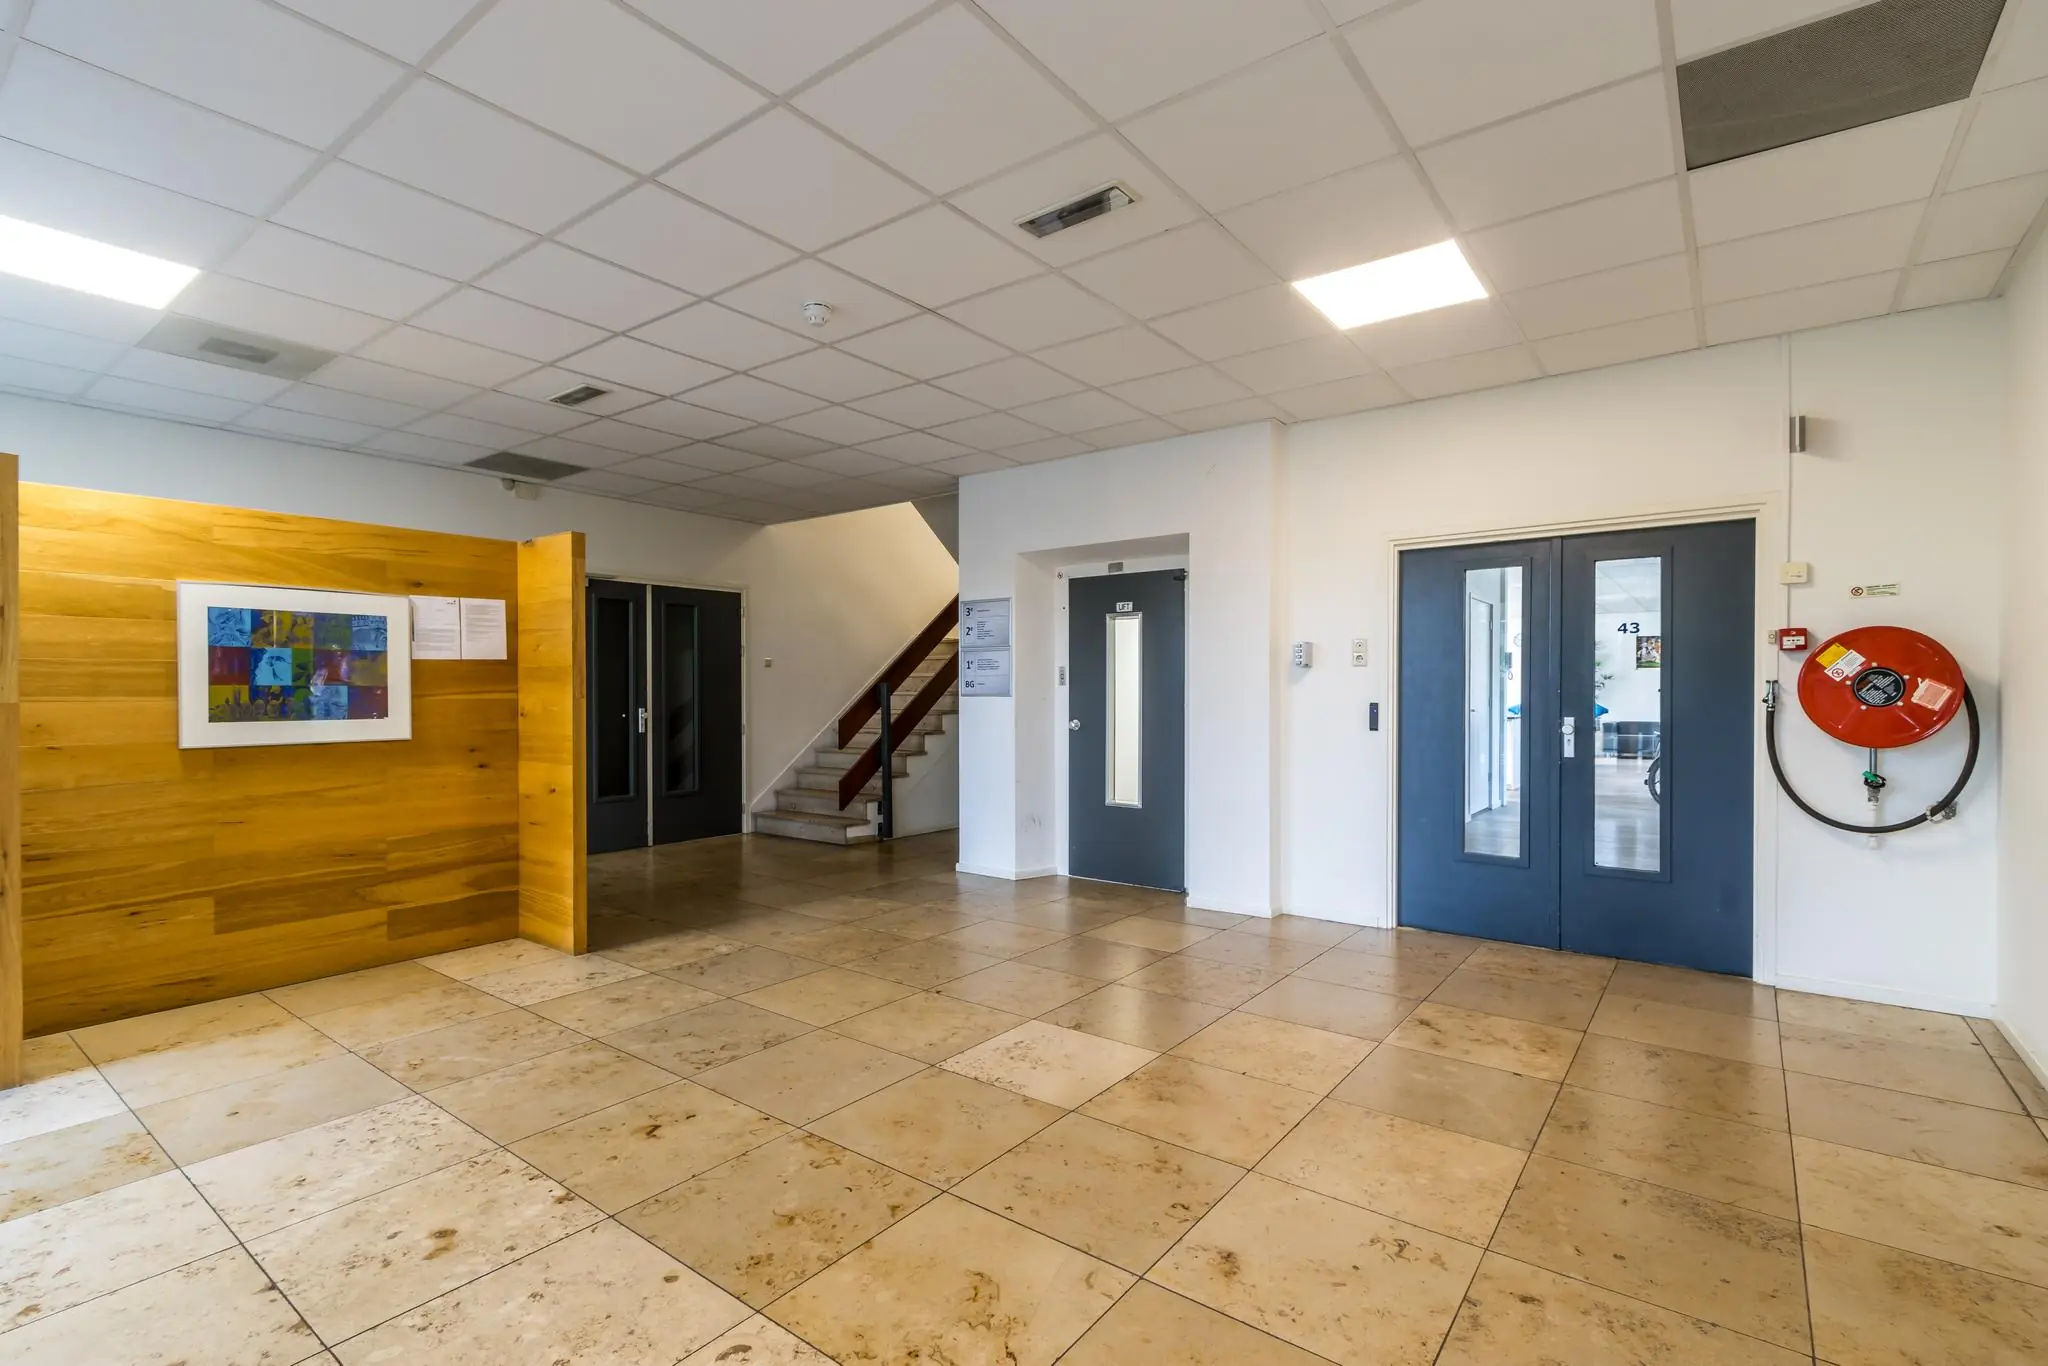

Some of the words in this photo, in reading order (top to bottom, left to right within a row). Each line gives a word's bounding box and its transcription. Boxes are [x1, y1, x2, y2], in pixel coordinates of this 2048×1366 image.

[1118, 602, 1131, 611] LIFT
[1617, 622, 1640, 634] 43
[965, 680, 975, 688] BG
